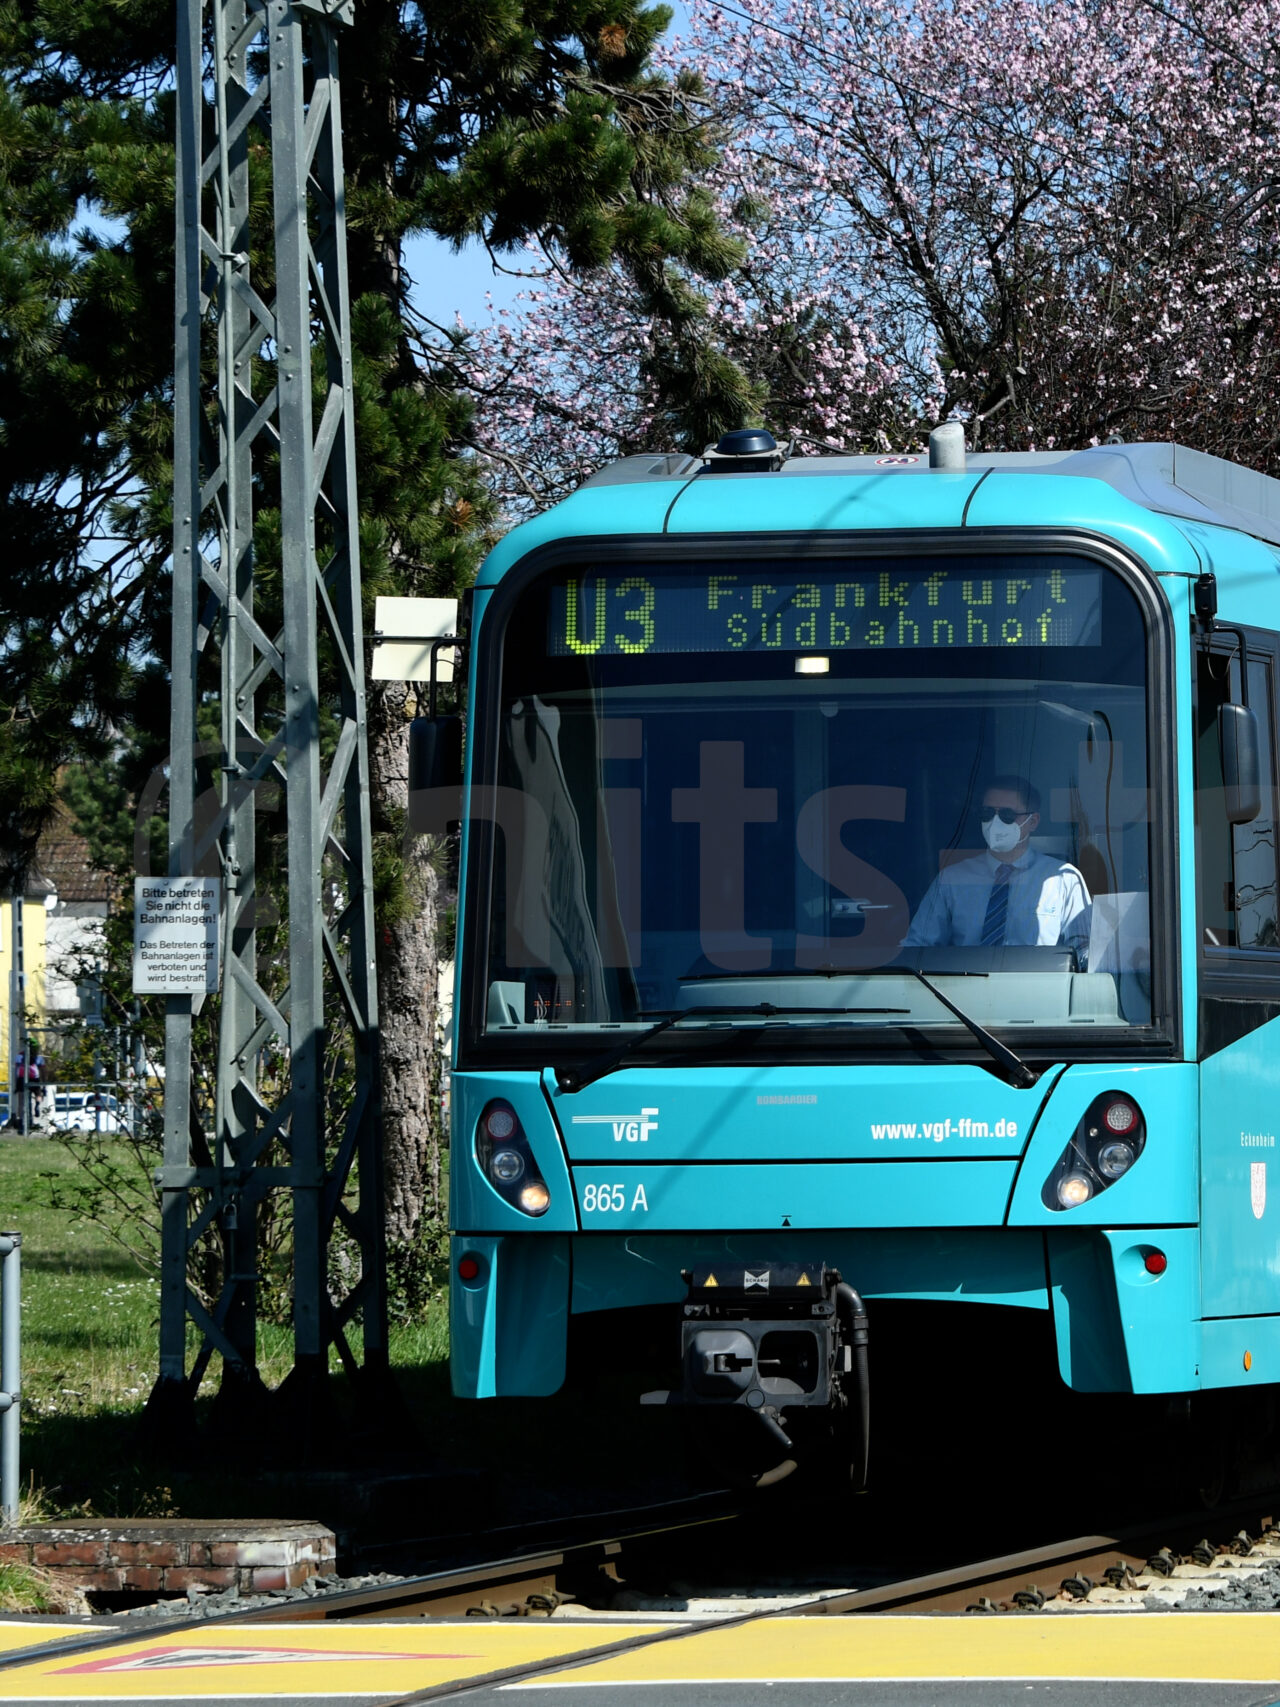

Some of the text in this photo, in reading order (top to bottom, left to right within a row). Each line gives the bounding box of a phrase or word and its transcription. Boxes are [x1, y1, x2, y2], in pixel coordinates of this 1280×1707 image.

[707, 569, 1067, 609] Frankfurt
[566, 577, 655, 654] U3
[727, 608, 1054, 647] Südbahnhof
[142, 888, 214, 898] Bitte betreten
[145, 901, 210, 911] Sie nicht die
[140, 914, 216, 925] Bahnanlagen!
[140, 940, 215, 949] Das Betreten der
[141, 952, 213, 961] Bahnanlagen ist
[147, 963, 208, 971] verboten und
[147, 974, 166, 982] wird
[612, 1107, 659, 1142] VGF
[871, 1118, 1018, 1142] www.vgf-ffm.de
[1240, 1131, 1275, 1147] Eckenheim
[583, 1184, 648, 1212] 865 A
